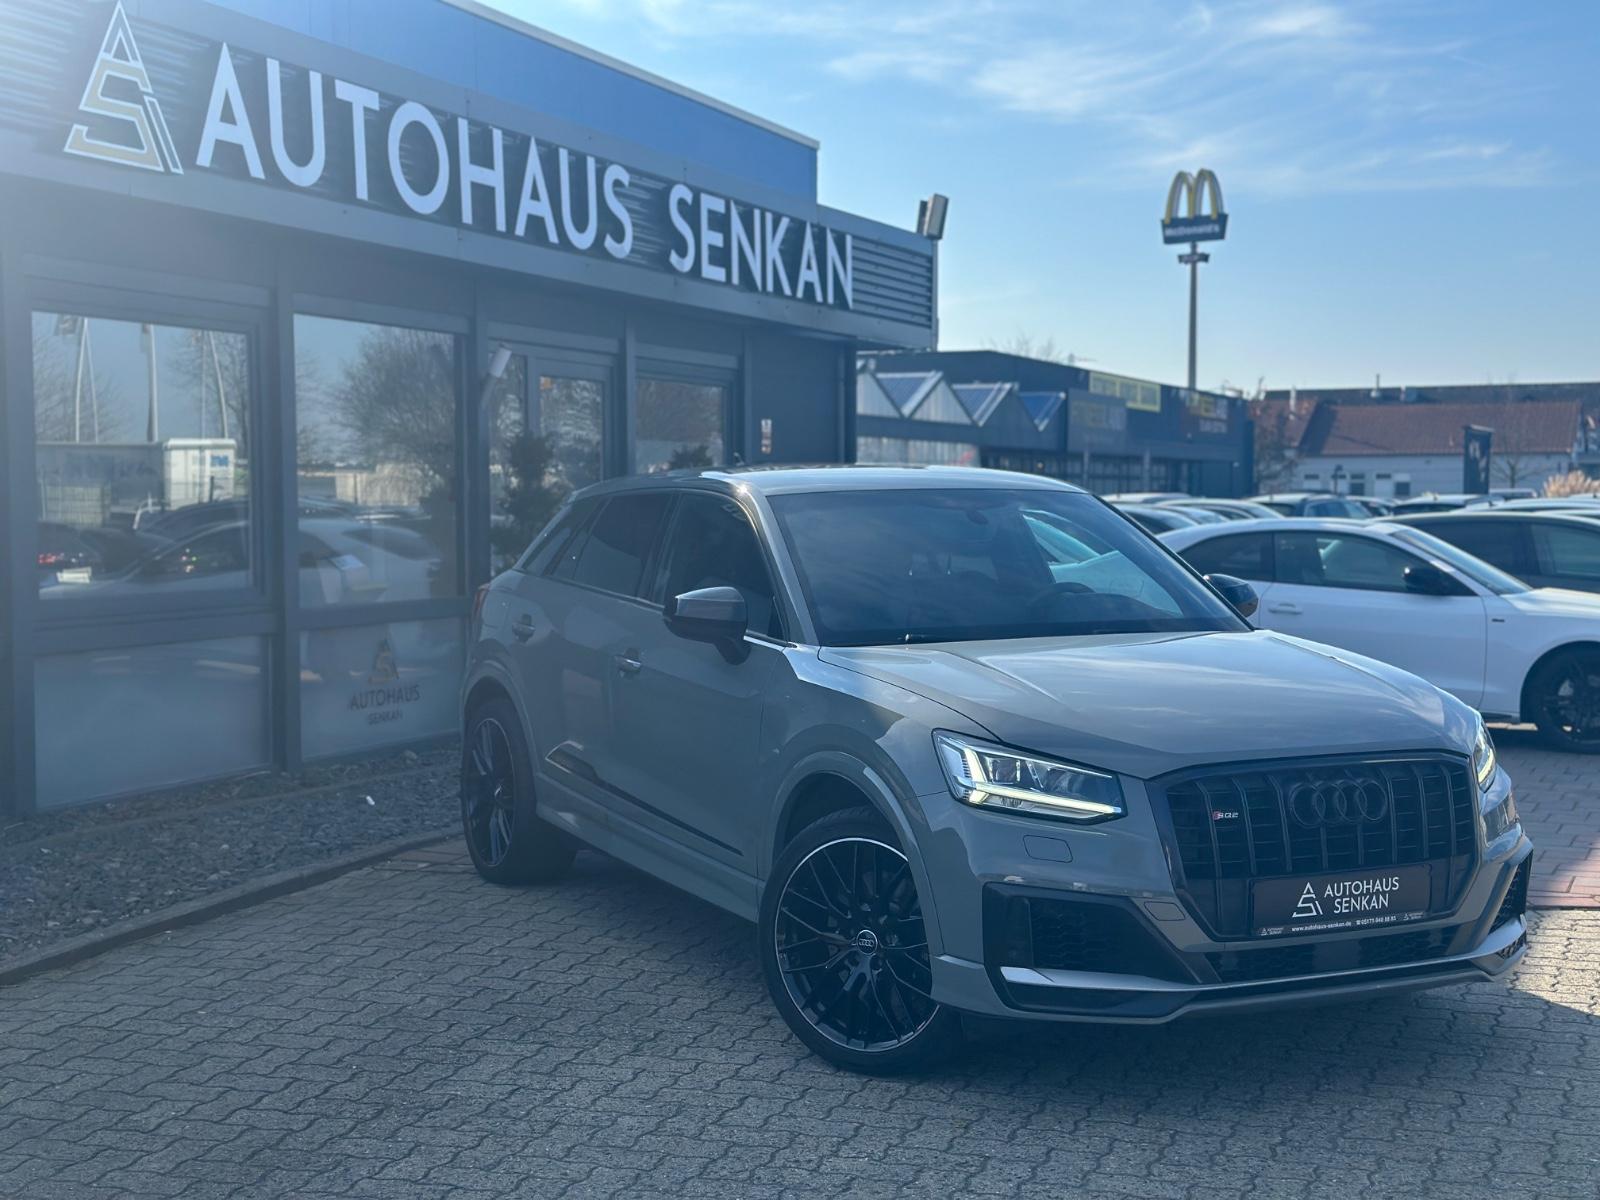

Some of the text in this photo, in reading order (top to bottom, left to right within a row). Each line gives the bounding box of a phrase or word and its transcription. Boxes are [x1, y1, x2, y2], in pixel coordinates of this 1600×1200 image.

[196, 42, 853, 309] AUTOHAUS SENKAN
[350, 684, 421, 711] AUTOHAUS
[1323, 876, 1400, 898] AUTOHAUS
[1333, 893, 1389, 914] SENKAN
